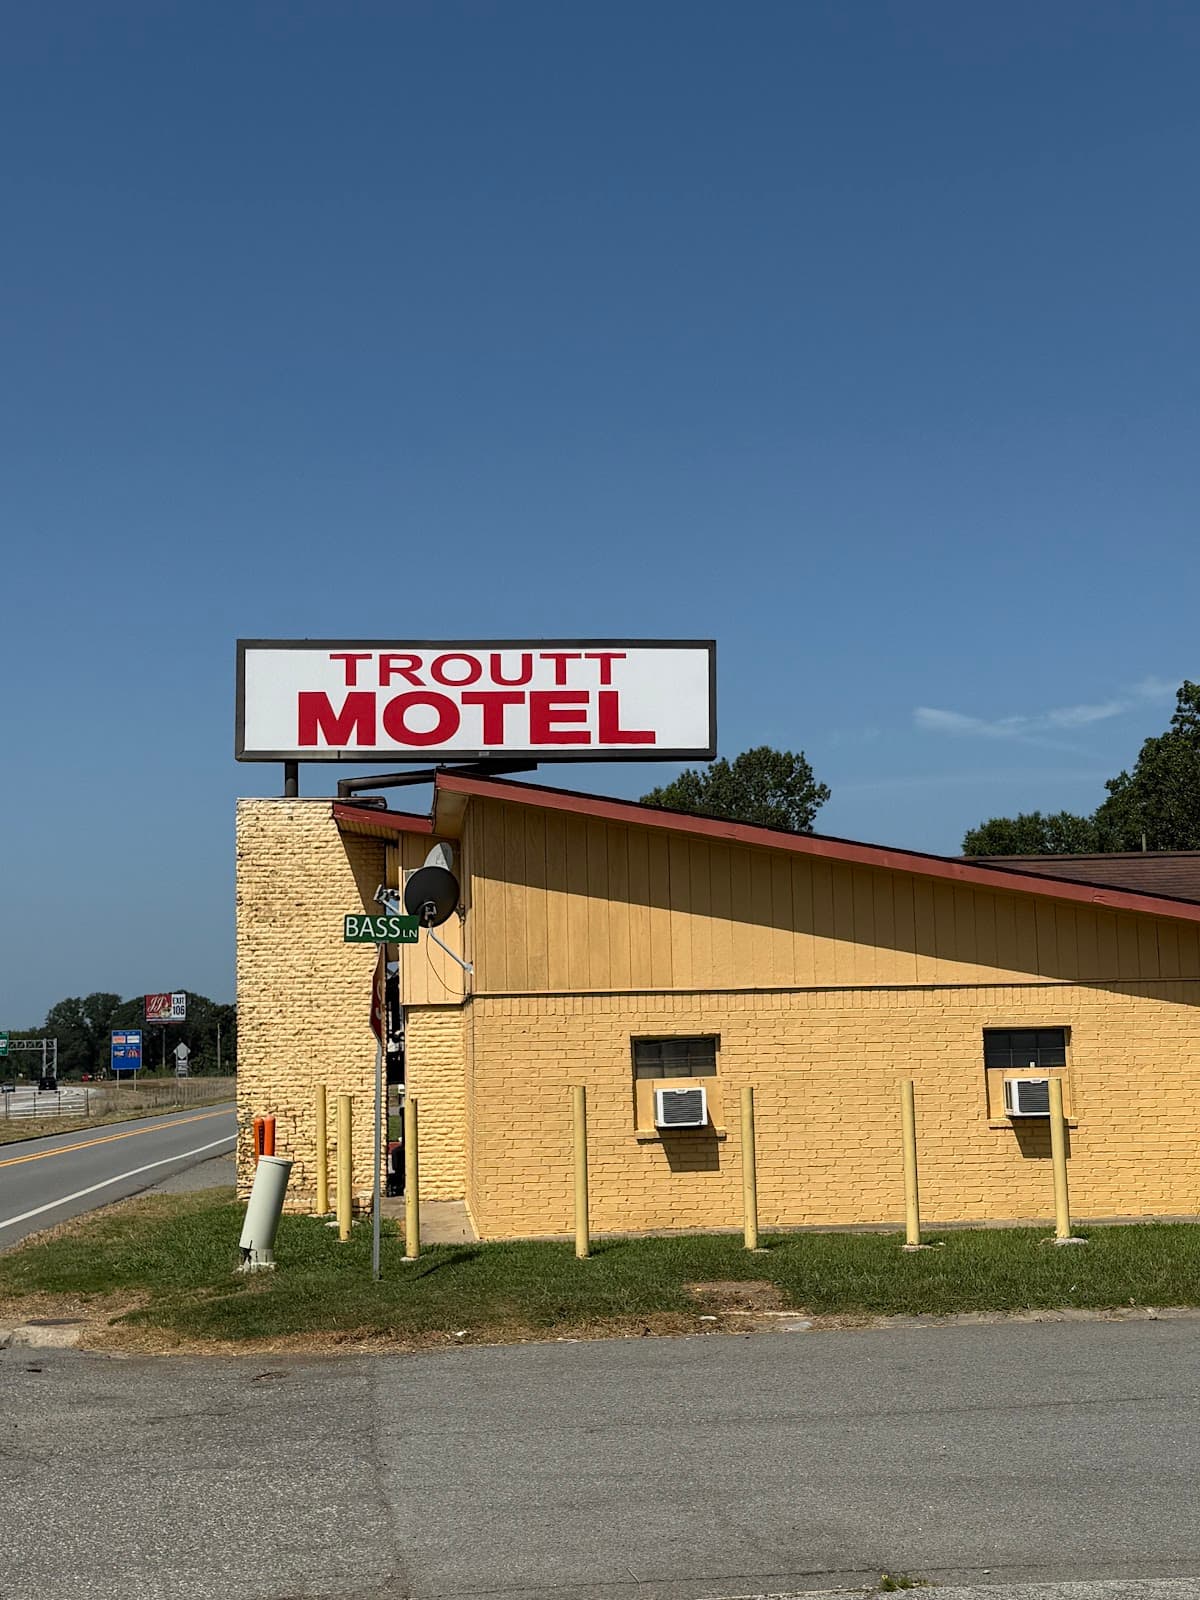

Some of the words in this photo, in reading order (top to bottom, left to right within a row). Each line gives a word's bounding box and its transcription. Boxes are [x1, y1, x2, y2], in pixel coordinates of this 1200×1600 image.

[330, 653, 626, 686] TROUTT
[298, 691, 656, 746] MOTEL
[346, 917, 400, 937] BASS
[403, 930, 417, 938] LN
[172, 997, 185, 1005] EXIT
[173, 1005, 185, 1016] 106
